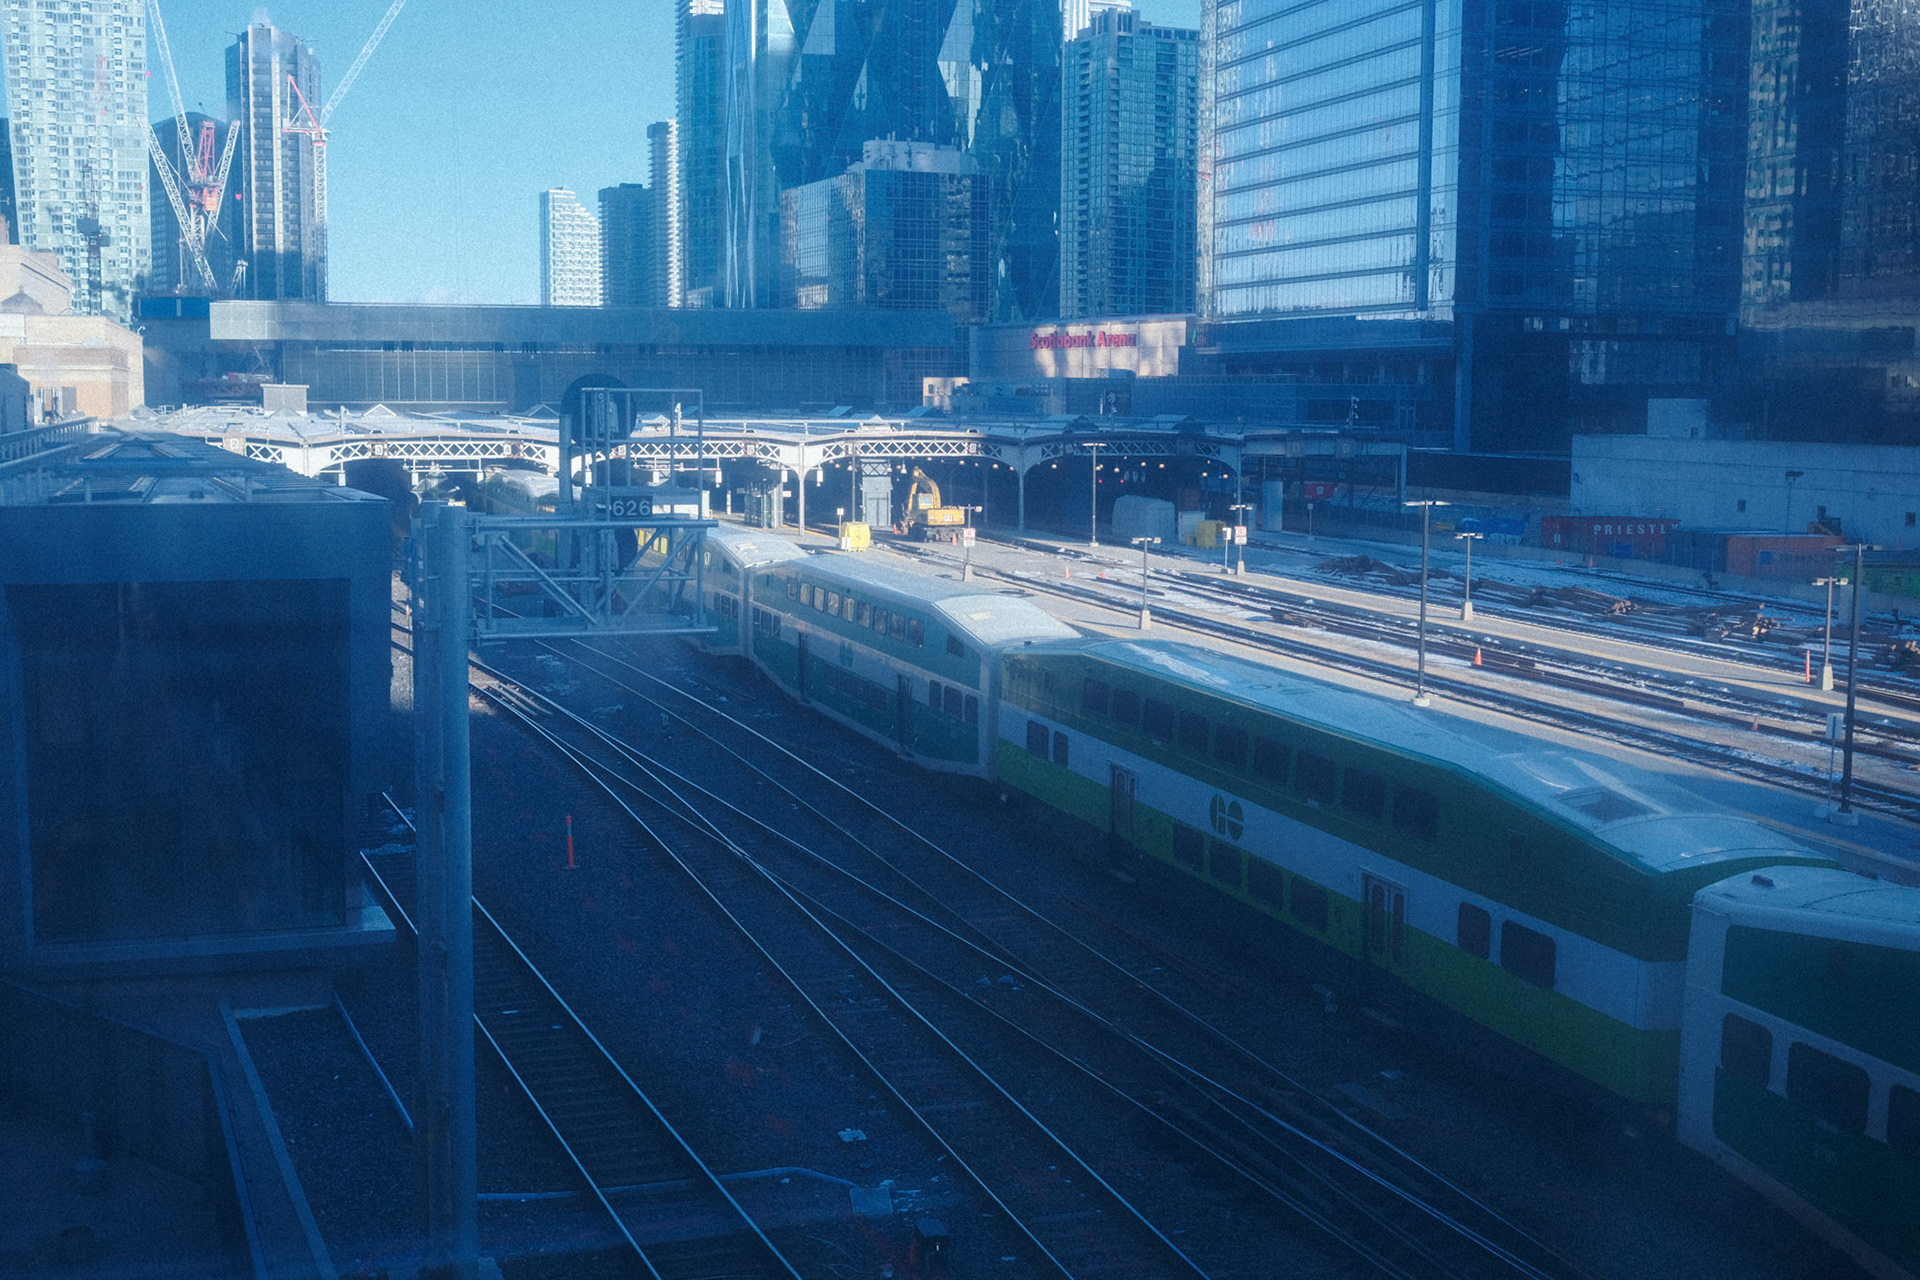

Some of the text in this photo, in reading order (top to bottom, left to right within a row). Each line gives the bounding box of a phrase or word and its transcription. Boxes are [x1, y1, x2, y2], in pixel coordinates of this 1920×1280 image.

[1030, 331, 1136, 348] Scotiabank Arena
[612, 500, 650, 516] 626
